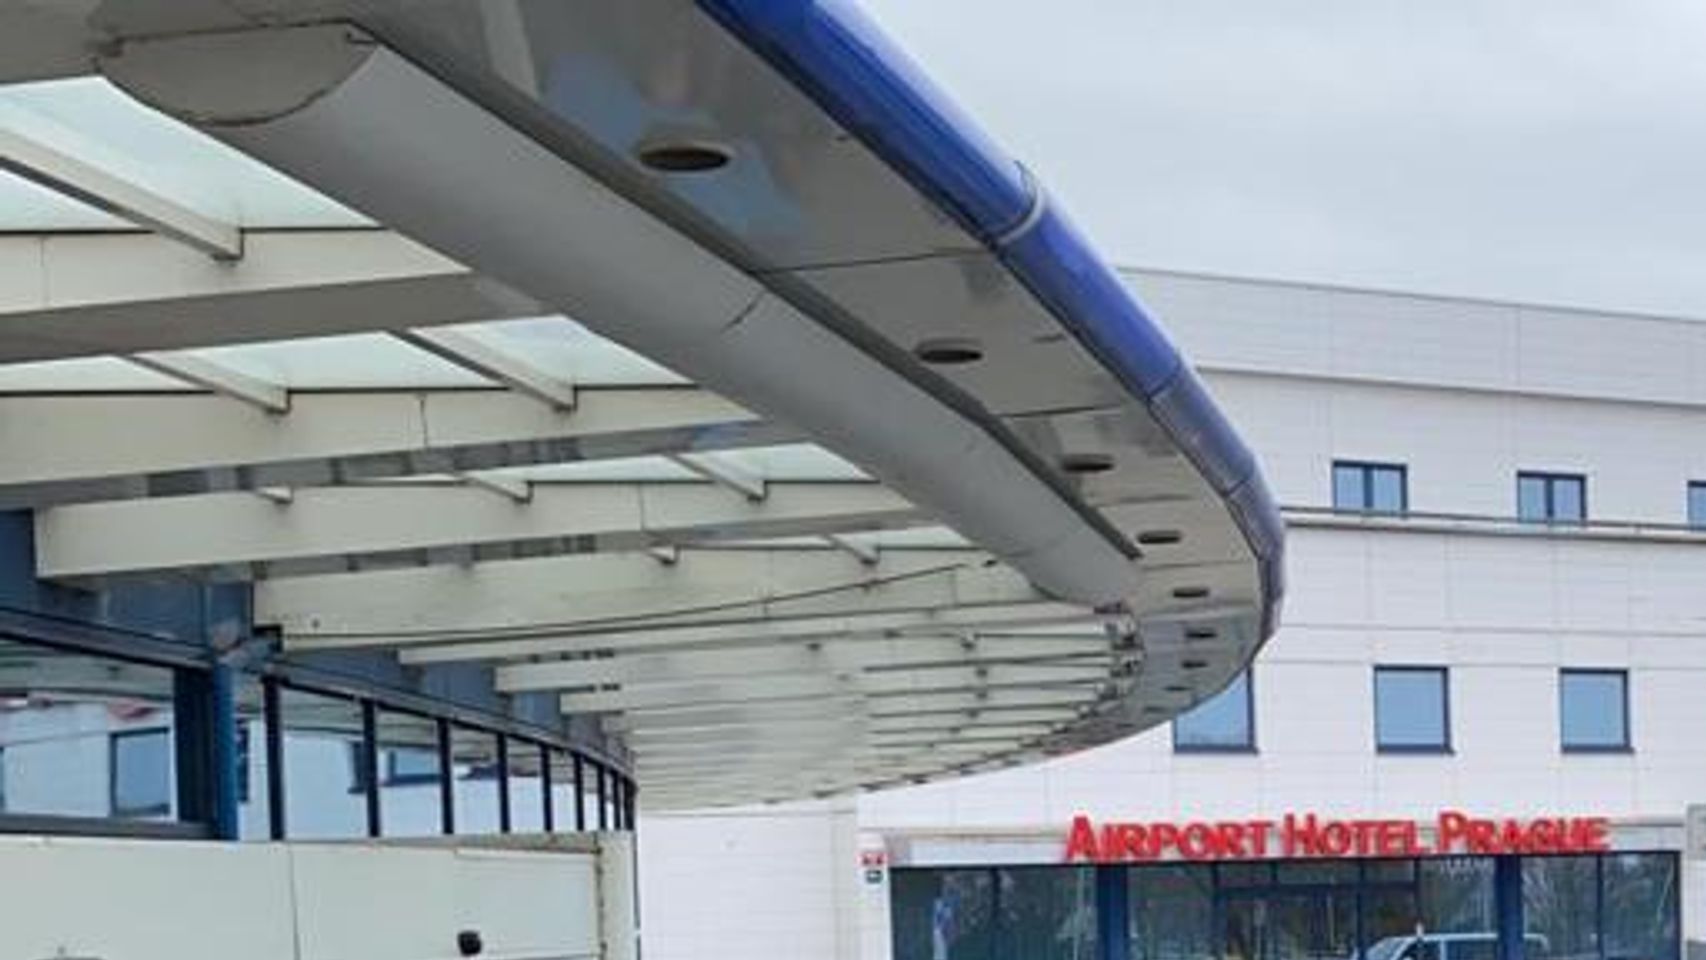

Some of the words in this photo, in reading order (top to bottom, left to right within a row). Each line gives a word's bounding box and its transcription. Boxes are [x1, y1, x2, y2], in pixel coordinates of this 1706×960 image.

[1065, 815, 1273, 862] AIRPORT
[1280, 813, 1425, 857] HOTEL
[1437, 811, 1612, 854] PRAGUE
